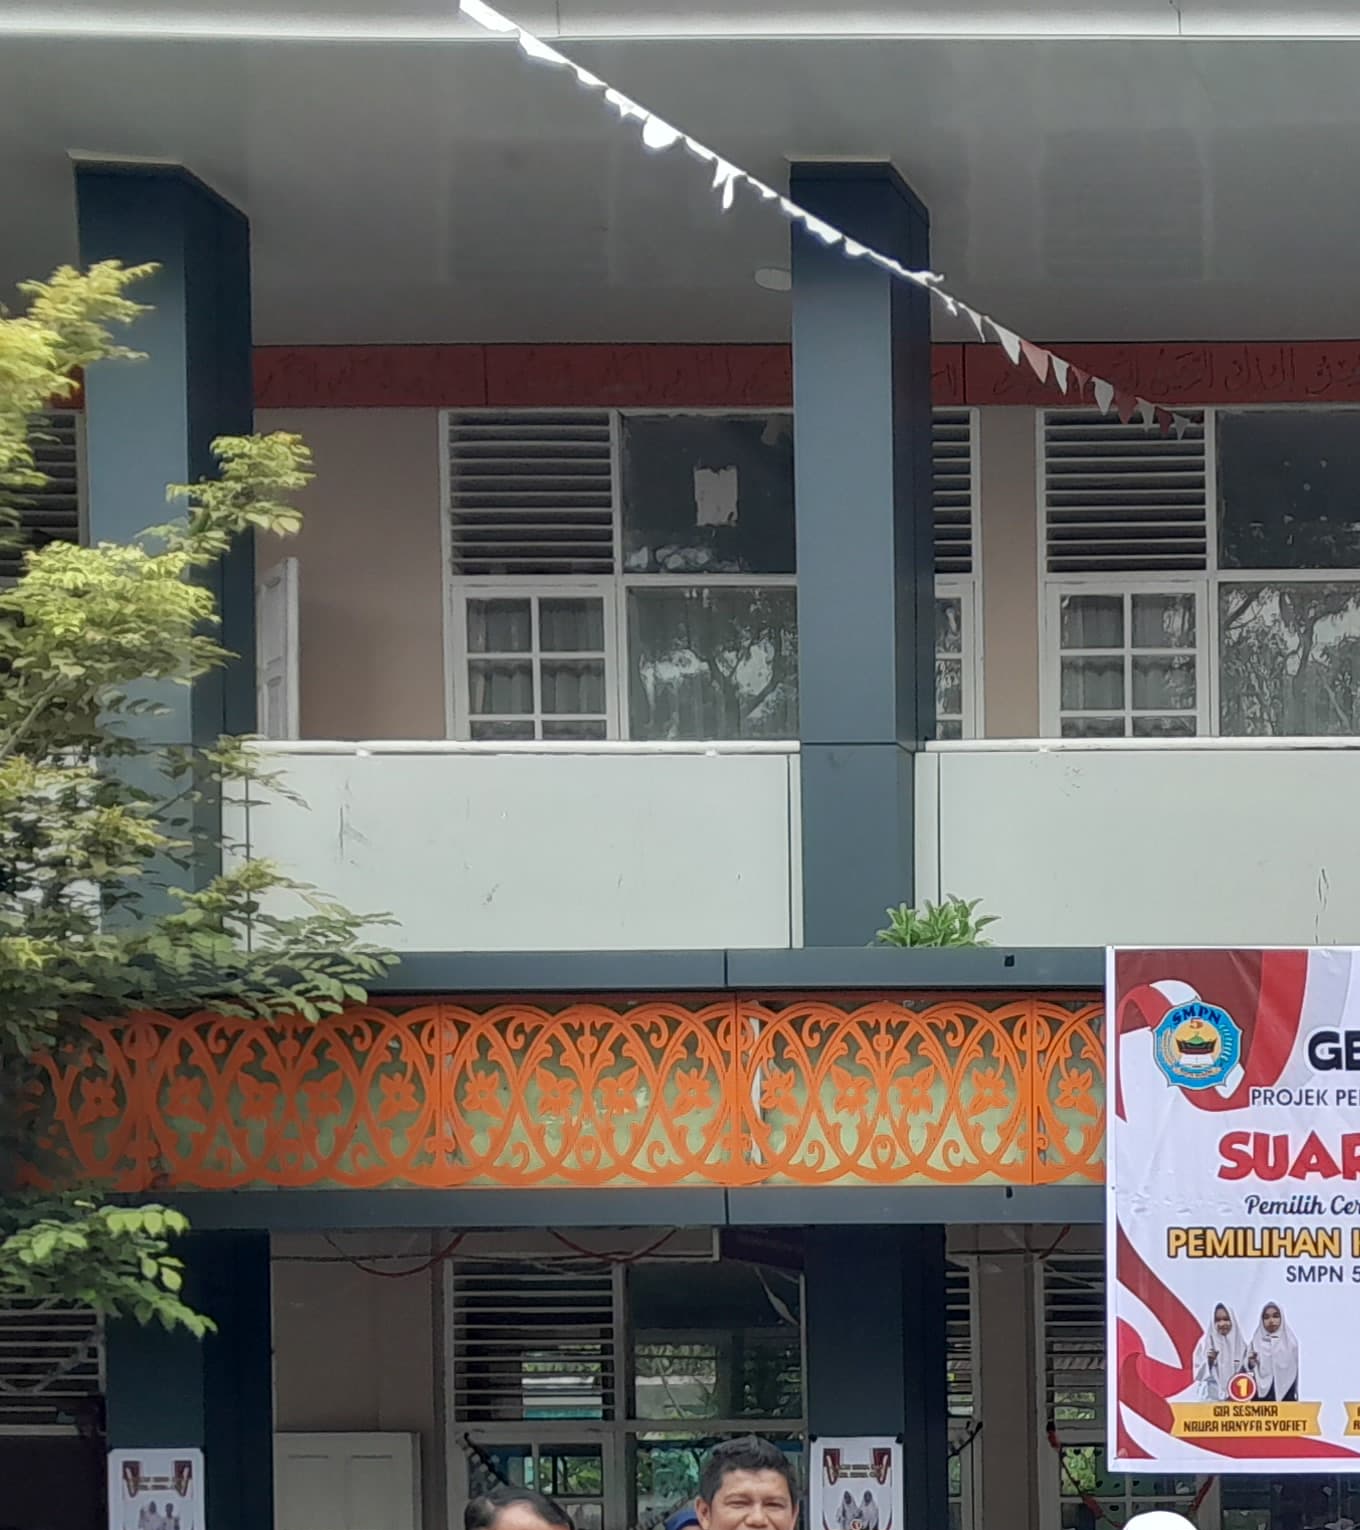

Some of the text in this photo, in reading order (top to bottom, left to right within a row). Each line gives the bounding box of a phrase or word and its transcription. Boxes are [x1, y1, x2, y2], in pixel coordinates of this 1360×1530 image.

[1171, 1004, 1223, 1026] SMPN
[1250, 1089, 1328, 1107] PROJEK
[1245, 1195, 1325, 1214] Pemilih
[1168, 1227, 1341, 1258] PEMILIHAN
[1287, 1266, 1343, 1282] SMPN
[1236, 1378, 1249, 1397] 1
[1232, 1404, 1279, 1417] SESMIKA
